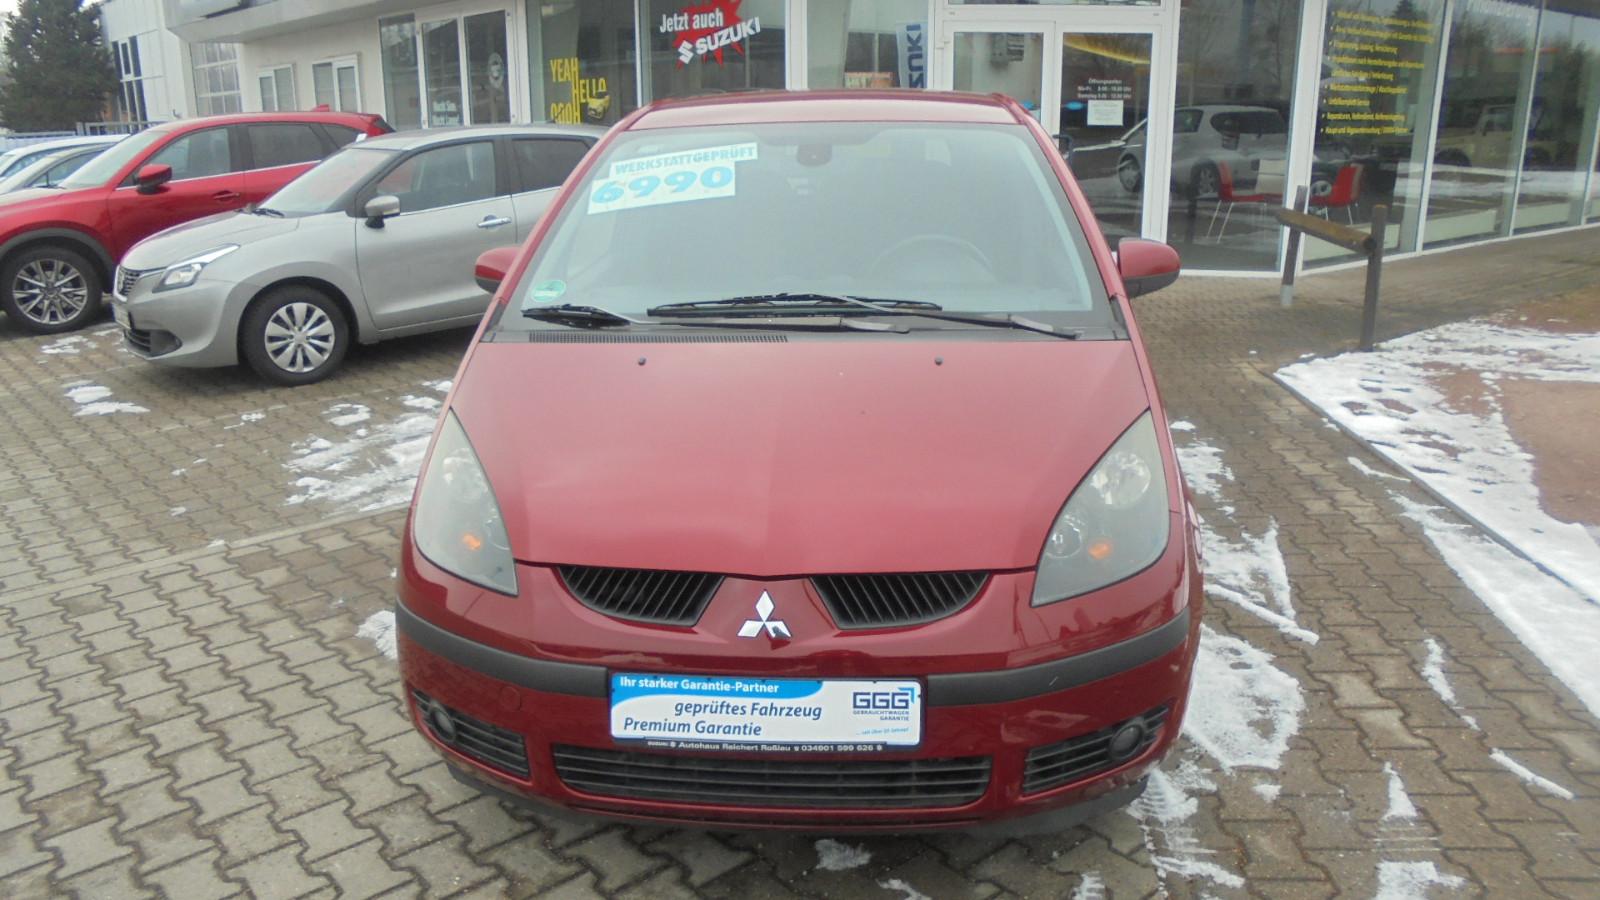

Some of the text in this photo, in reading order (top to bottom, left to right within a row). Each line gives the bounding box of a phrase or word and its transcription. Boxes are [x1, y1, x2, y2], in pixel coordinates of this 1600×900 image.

[660, 8, 724, 33] Jetzt auch
[695, 16, 761, 55] SUZUKI
[550, 57, 579, 82] YEAH
[615, 146, 755, 175] WERKSTATTGEPRÜFT
[591, 166, 733, 204] 6990
[620, 676, 779, 694] Ihr starker Garantie-Partner
[674, 700, 822, 721] geprüftes Fahrzeug
[853, 692, 909, 709] GGG
[623, 716, 762, 737] Premium Garantie
[678, 741, 720, 750] Autohaus
[722, 743, 759, 751] Reichert
